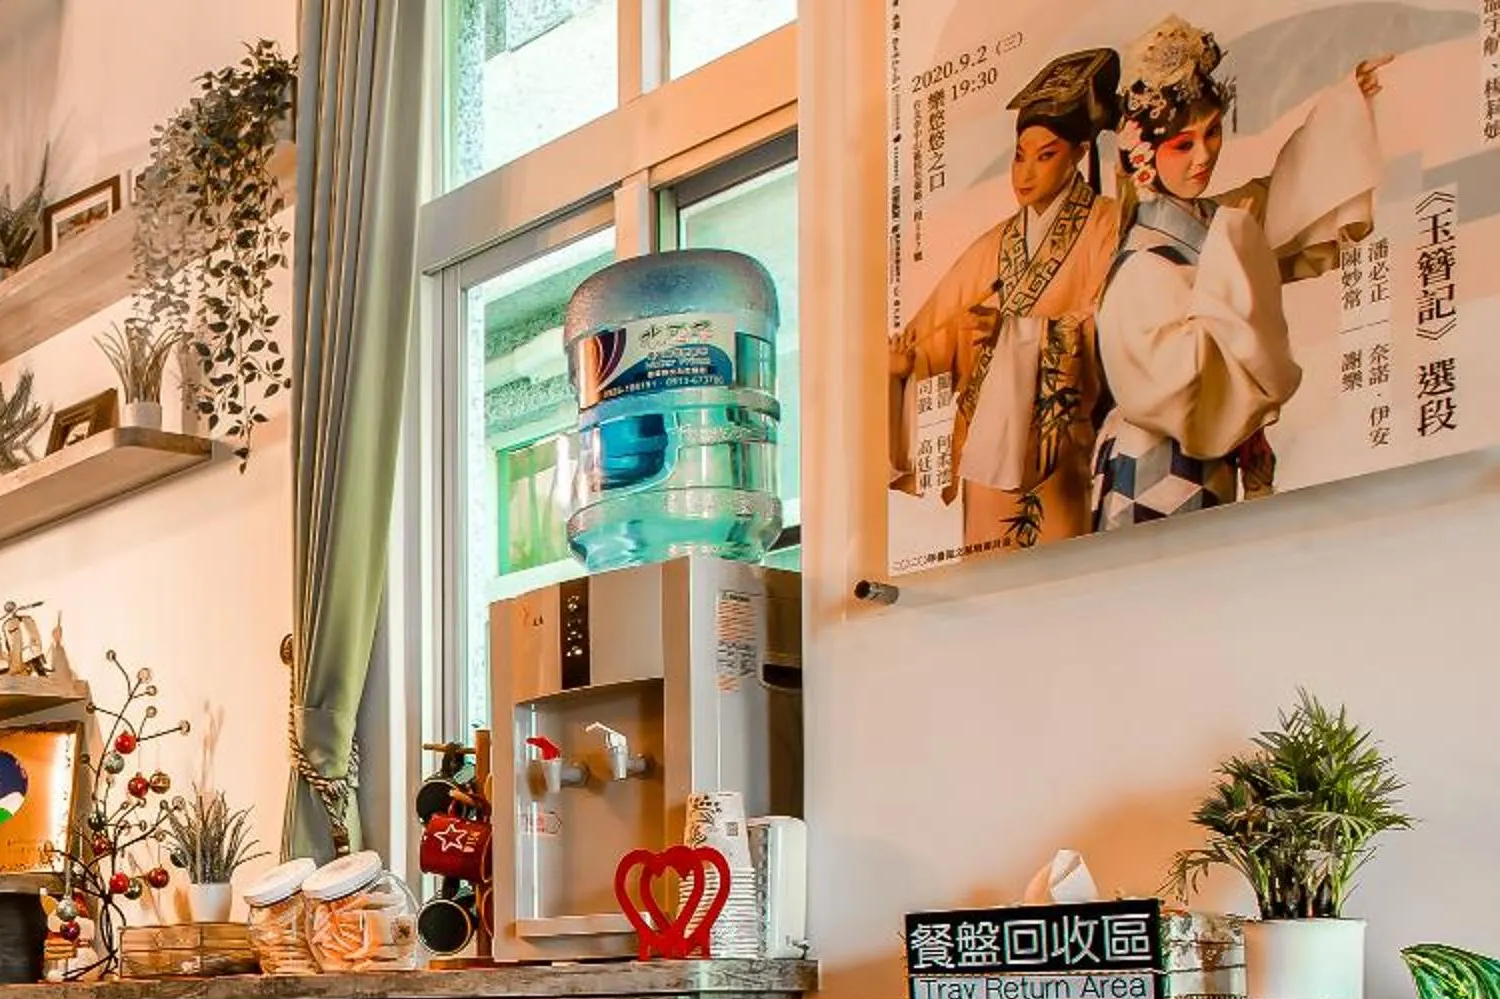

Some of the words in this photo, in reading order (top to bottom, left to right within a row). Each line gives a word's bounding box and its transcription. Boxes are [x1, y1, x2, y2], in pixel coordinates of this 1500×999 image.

[912, 46, 987, 93] 2020.9.2
[951, 68, 997, 101] 19:30
[1341, 247, 1362, 310] 陳妙常
[1368, 237, 1390, 303] 潘必正
[1417, 358, 1457, 436] 選段
[910, 913, 1153, 970] 餐盤回收區
[1080, 975, 1146, 999] Area
